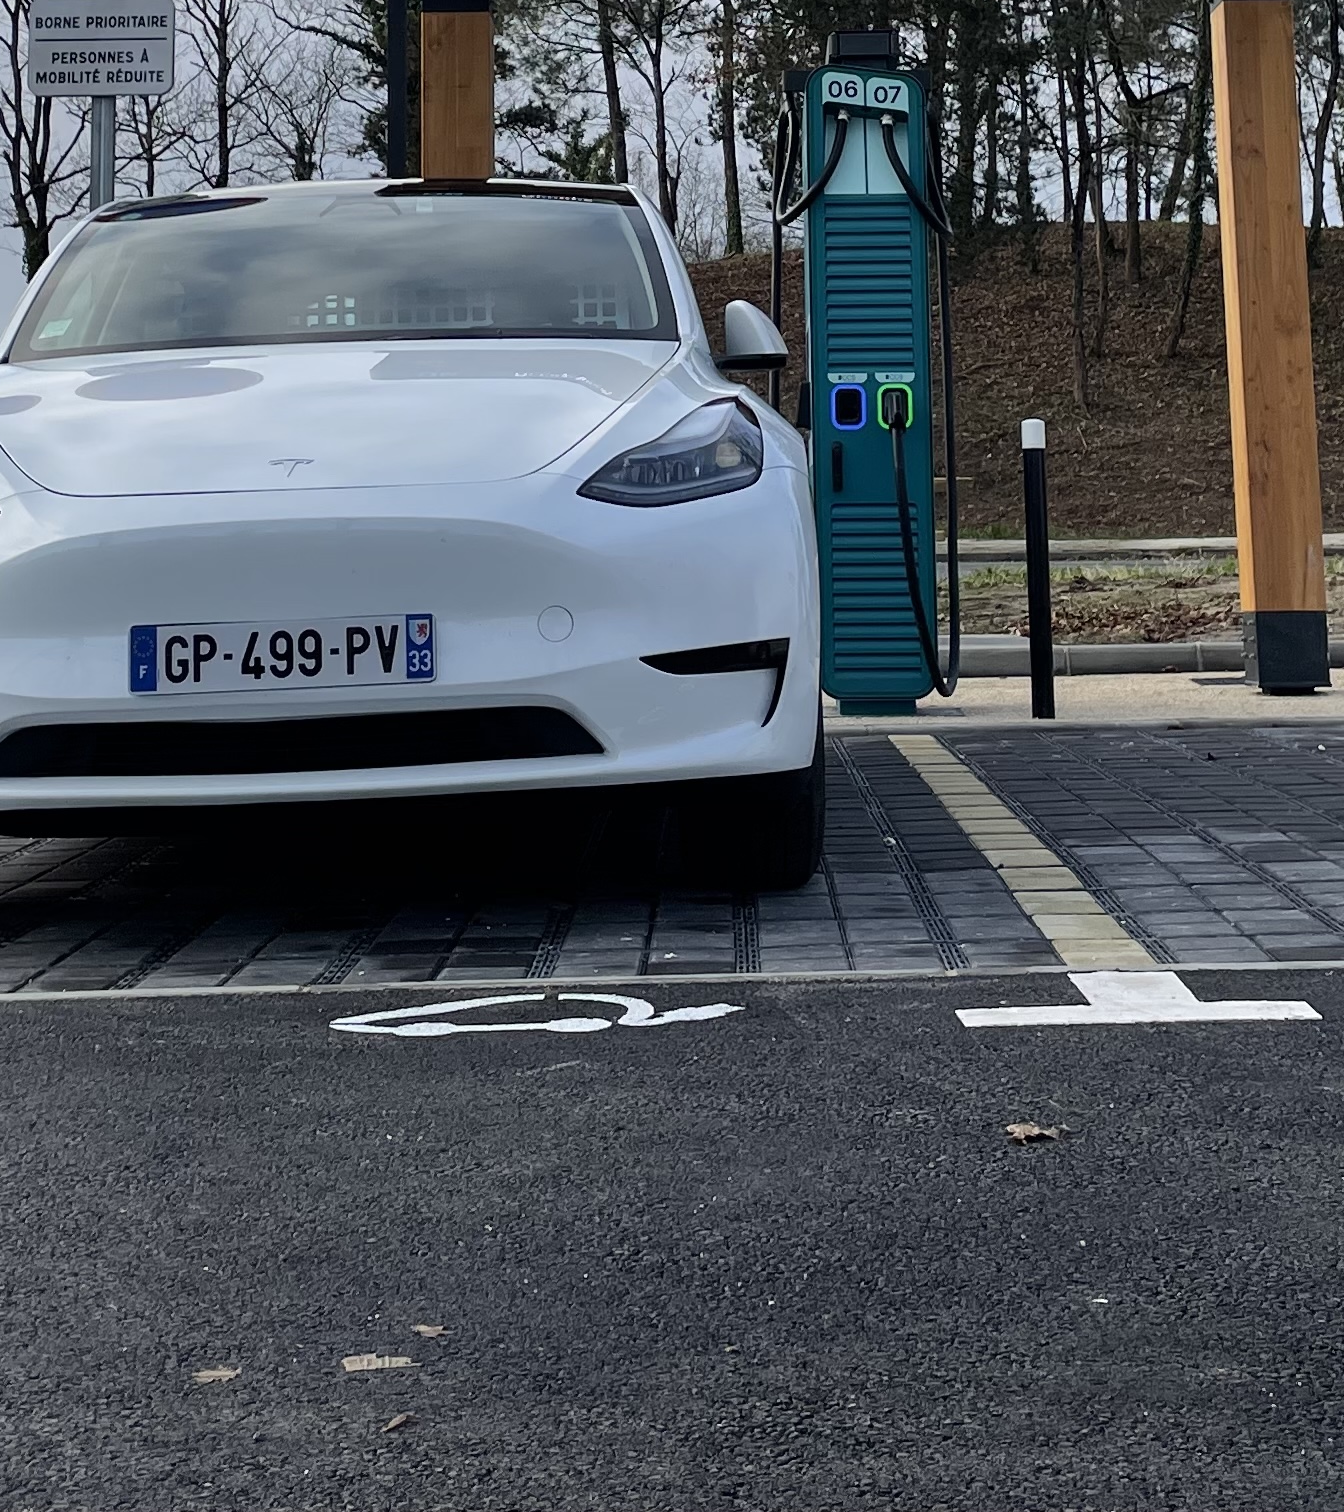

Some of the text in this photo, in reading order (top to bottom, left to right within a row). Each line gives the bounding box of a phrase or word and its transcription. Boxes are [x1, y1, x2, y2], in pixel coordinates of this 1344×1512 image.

[35, 15, 168, 29] BORNE PRIORITAIRE
[51, 50, 134, 65] PERSONNES
[35, 67, 165, 85] MOBILITÉ RÉDUITE
[828, 80, 858, 98] 06
[873, 85, 902, 104] 07
[164, 624, 399, 684] GP-499-PV
[408, 649, 432, 672] 33
[139, 665, 148, 680] F
